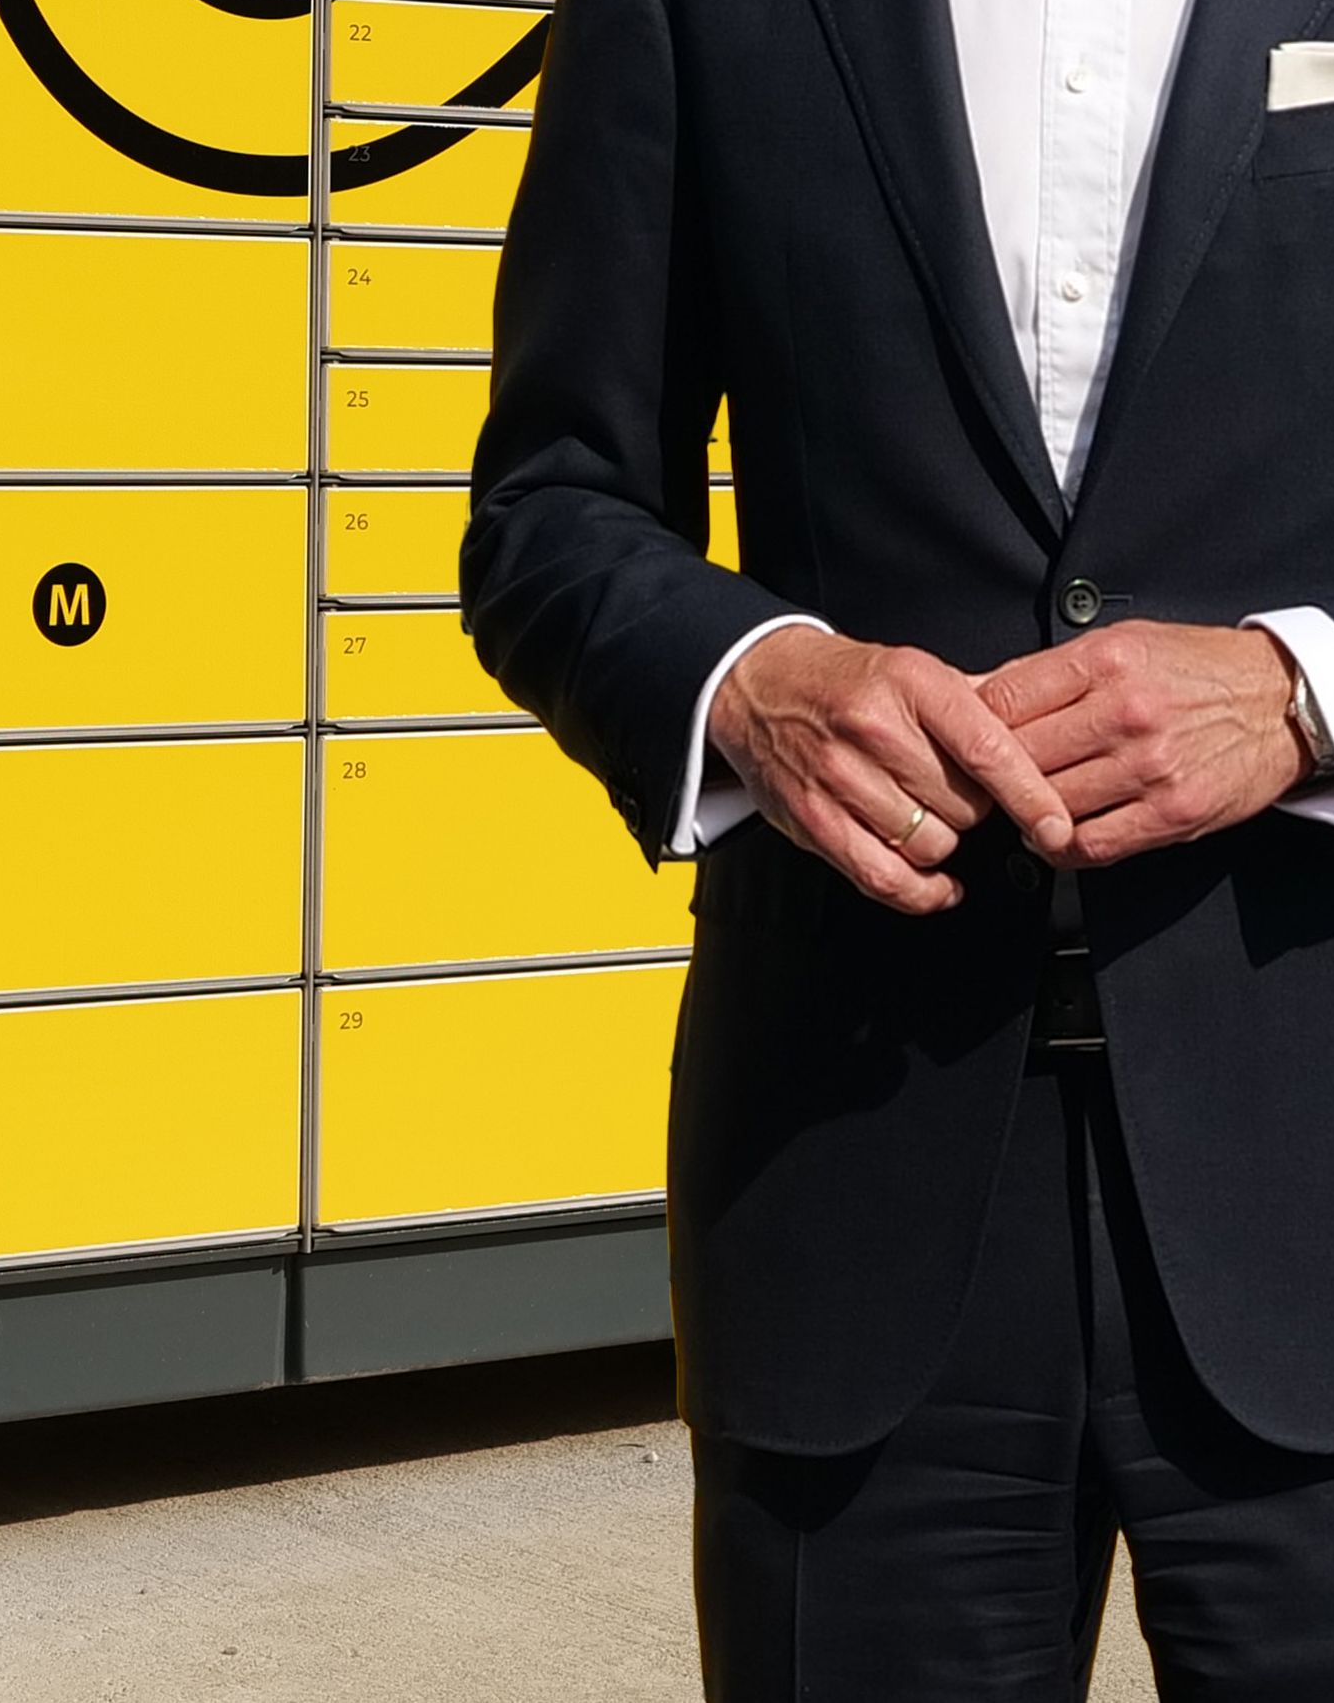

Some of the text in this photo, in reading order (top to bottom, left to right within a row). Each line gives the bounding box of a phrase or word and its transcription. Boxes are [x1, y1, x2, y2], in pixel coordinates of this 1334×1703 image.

[350, 25, 371, 41] 22
[348, 144, 372, 163] 23
[348, 269, 371, 285] 24
[347, 391, 368, 407] 25
[346, 514, 368, 530] 26
[49, 584, 89, 626] M
[344, 637, 367, 654] 27
[343, 762, 366, 779] 28
[340, 1012, 362, 1029] 29
